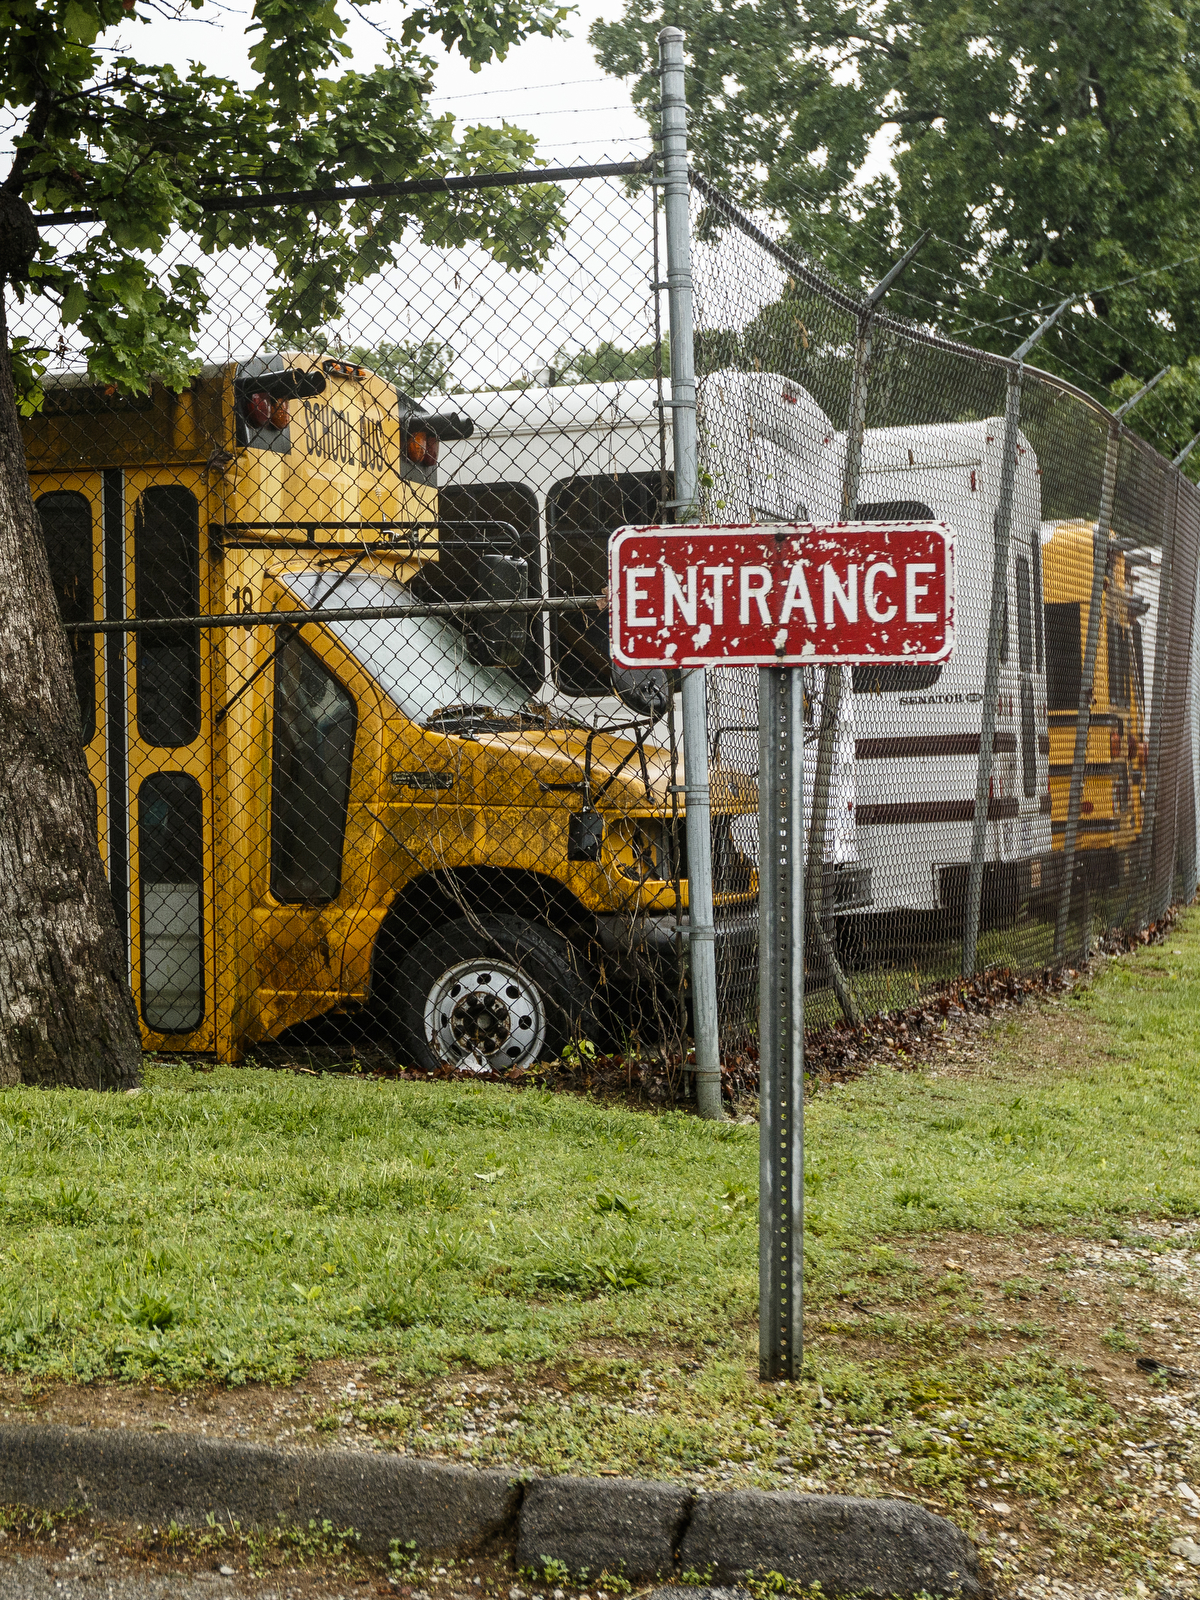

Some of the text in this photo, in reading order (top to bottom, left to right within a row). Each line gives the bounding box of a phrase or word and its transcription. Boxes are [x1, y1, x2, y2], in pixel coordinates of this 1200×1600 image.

[304, 400, 384, 473] SCHOOL BUS
[626, 563, 938, 627] ENTRANCE
